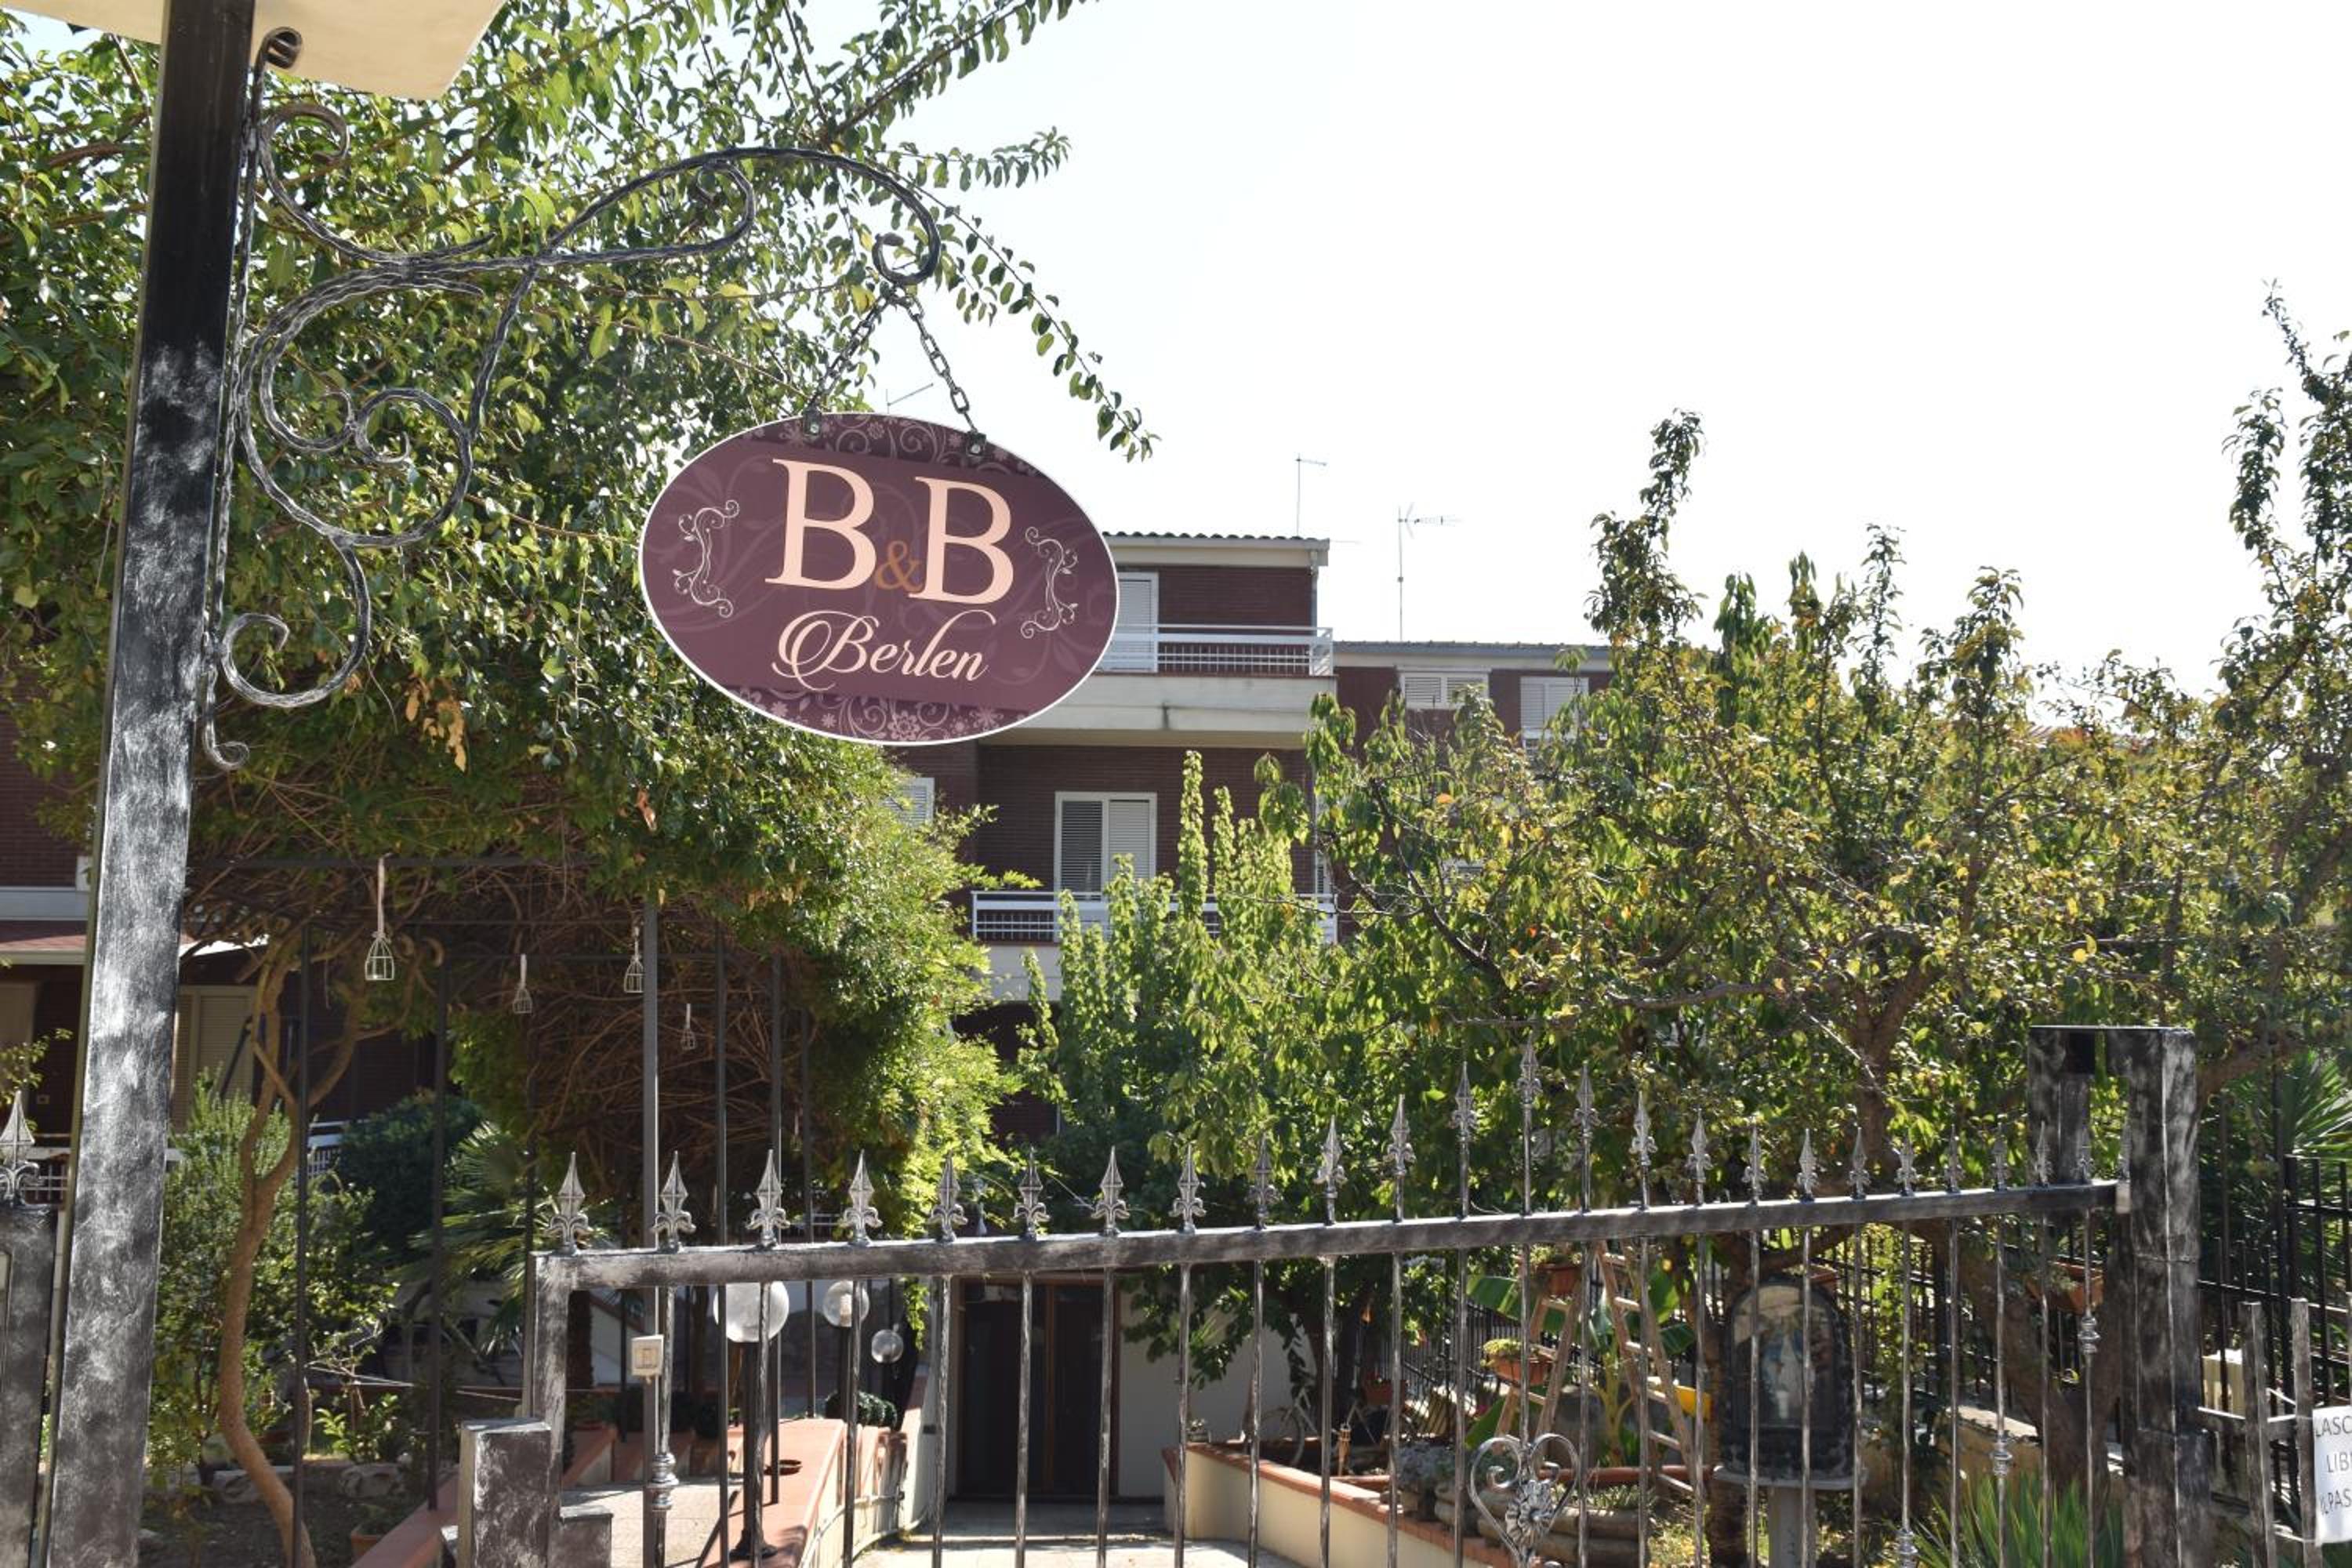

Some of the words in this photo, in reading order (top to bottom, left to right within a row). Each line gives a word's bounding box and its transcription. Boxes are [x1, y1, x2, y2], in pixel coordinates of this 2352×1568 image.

[765, 459, 1014, 604] B&B
[772, 610, 996, 691] Berlen
[2326, 1451, 2352, 1472] LIB
